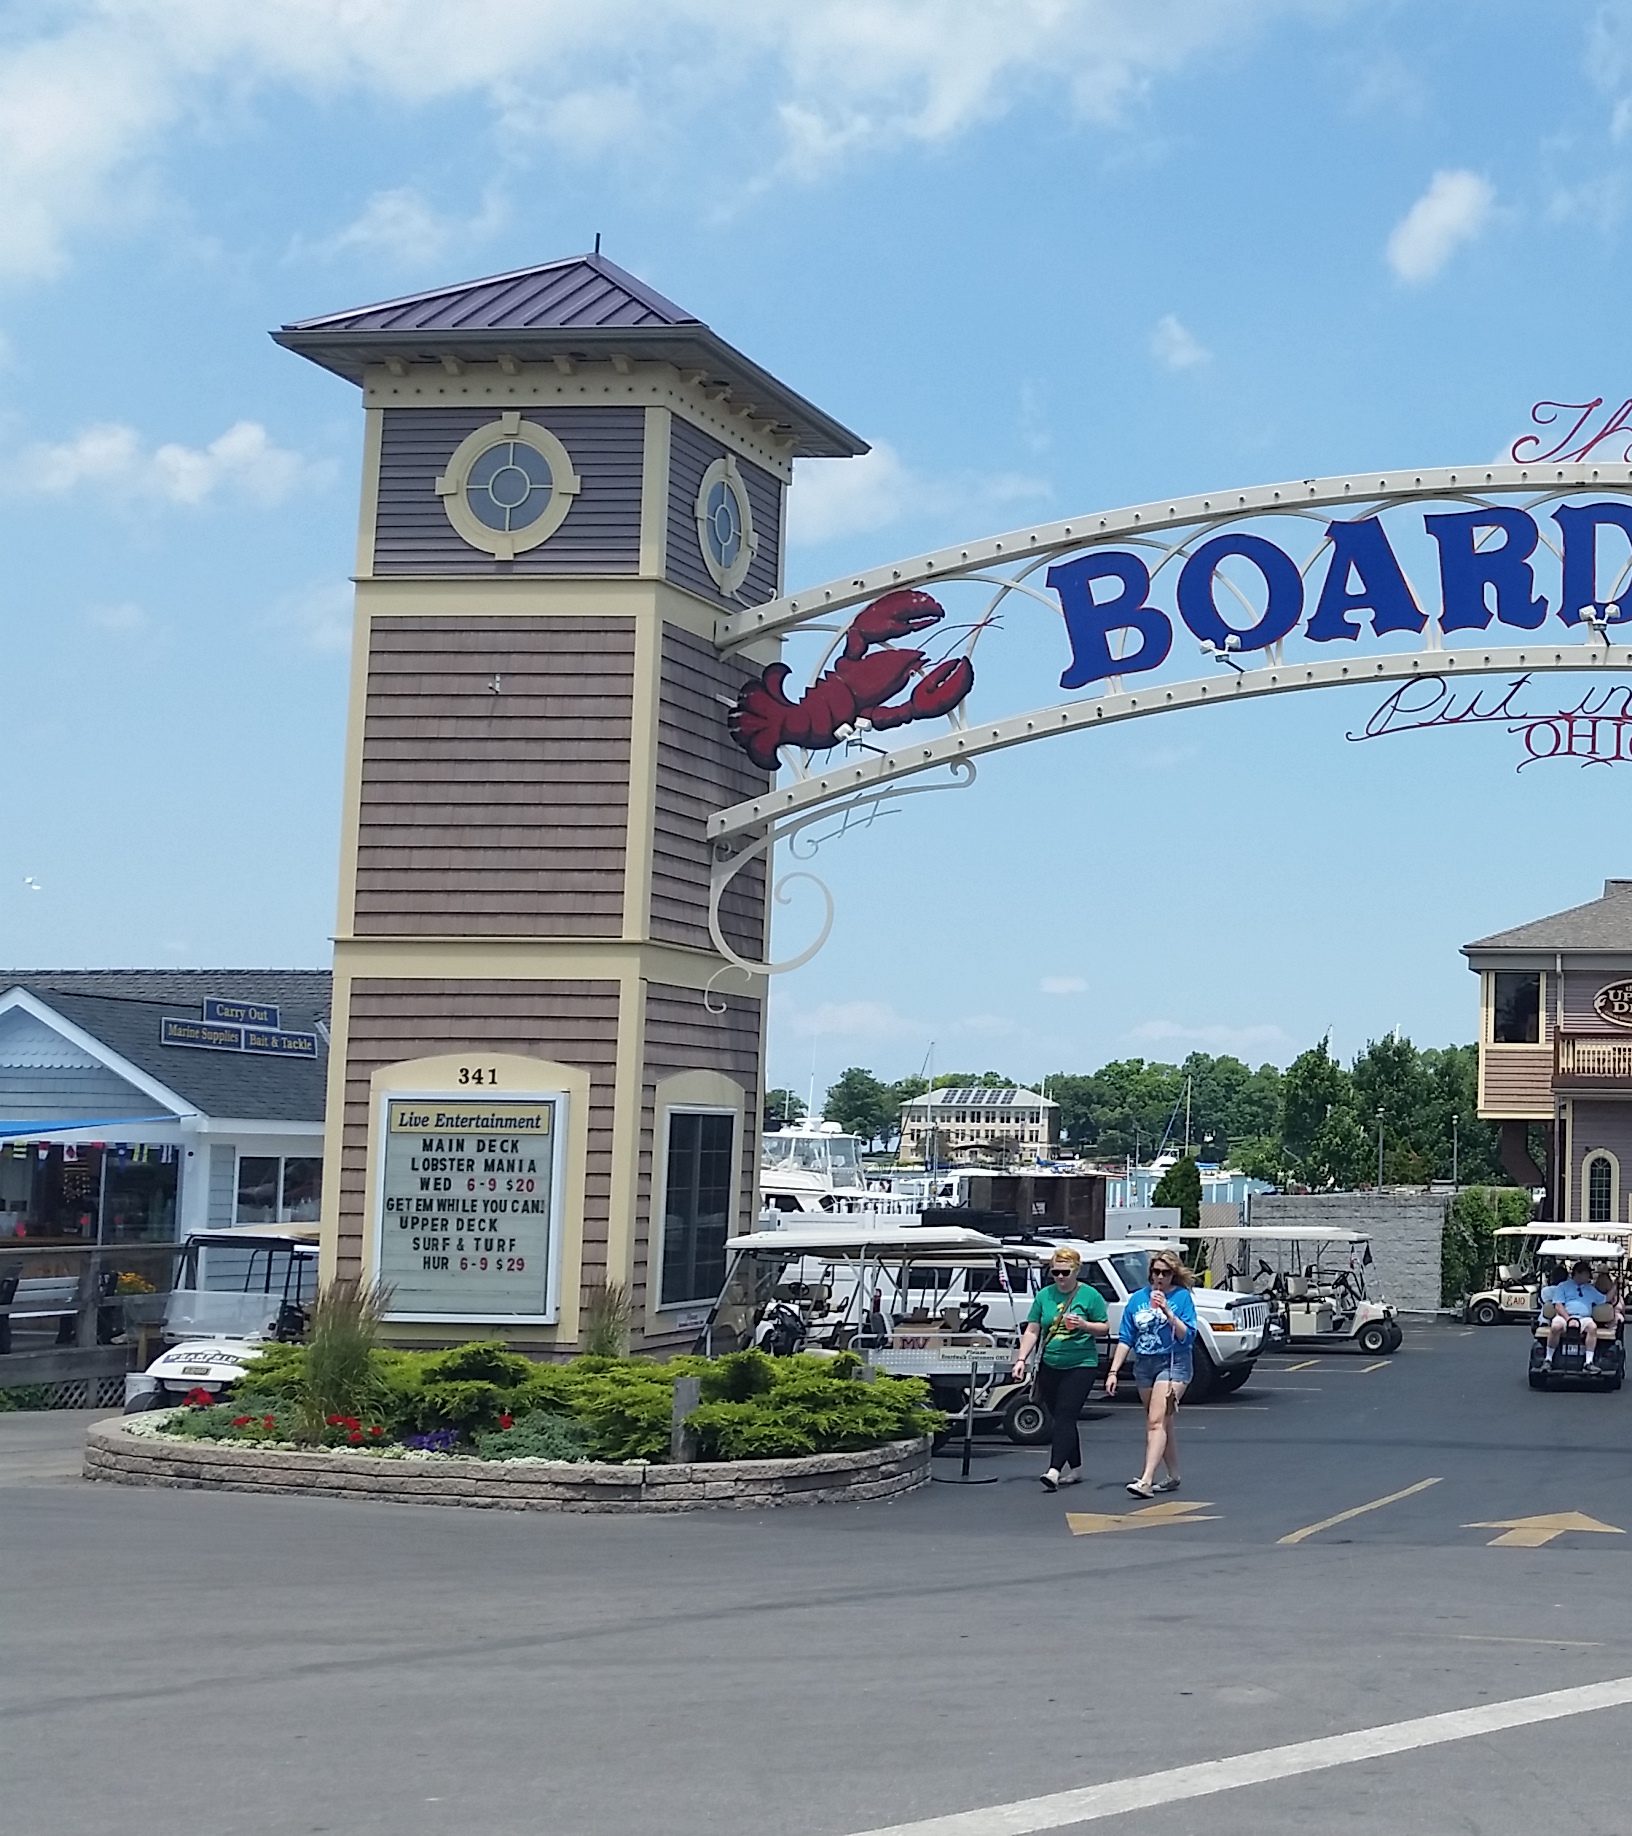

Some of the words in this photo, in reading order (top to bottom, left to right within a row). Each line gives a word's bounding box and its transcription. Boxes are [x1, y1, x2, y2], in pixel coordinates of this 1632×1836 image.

[1366, 672, 1533, 737] Put
[216, 1004, 245, 1020] Carry
[249, 1008, 268, 1021] Out
[168, 1024, 199, 1038] Marine
[202, 1027, 238, 1044] Supplies
[250, 1034, 268, 1047] Bait
[271, 1037, 278, 1048] &
[281, 1037, 312, 1050] Tackle
[458, 1068, 498, 1085] 341
[399, 1112, 430, 1128] Live
[434, 1113, 542, 1129] Entertainment
[422, 1138, 465, 1152] MAIN
[476, 1139, 520, 1153] DECK
[411, 1158, 475, 1172] LOBSTER
[483, 1159, 536, 1173] MANIA
[420, 1178, 452, 1191] WED
[506, 1178, 535, 1192] $20
[386, 1197, 411, 1212] GET
[415, 1198, 434, 1212] EM
[437, 1198, 477, 1213] WHILE
[482, 1199, 507, 1213] YOU
[400, 1217, 449, 1230] UPPER
[456, 1218, 498, 1231] DECK
[412, 1237, 450, 1250] SURF
[457, 1238, 464, 1251] &
[474, 1238, 516, 1251] TURF
[423, 1256, 449, 1270] HUR
[496, 1257, 525, 1271] $29
